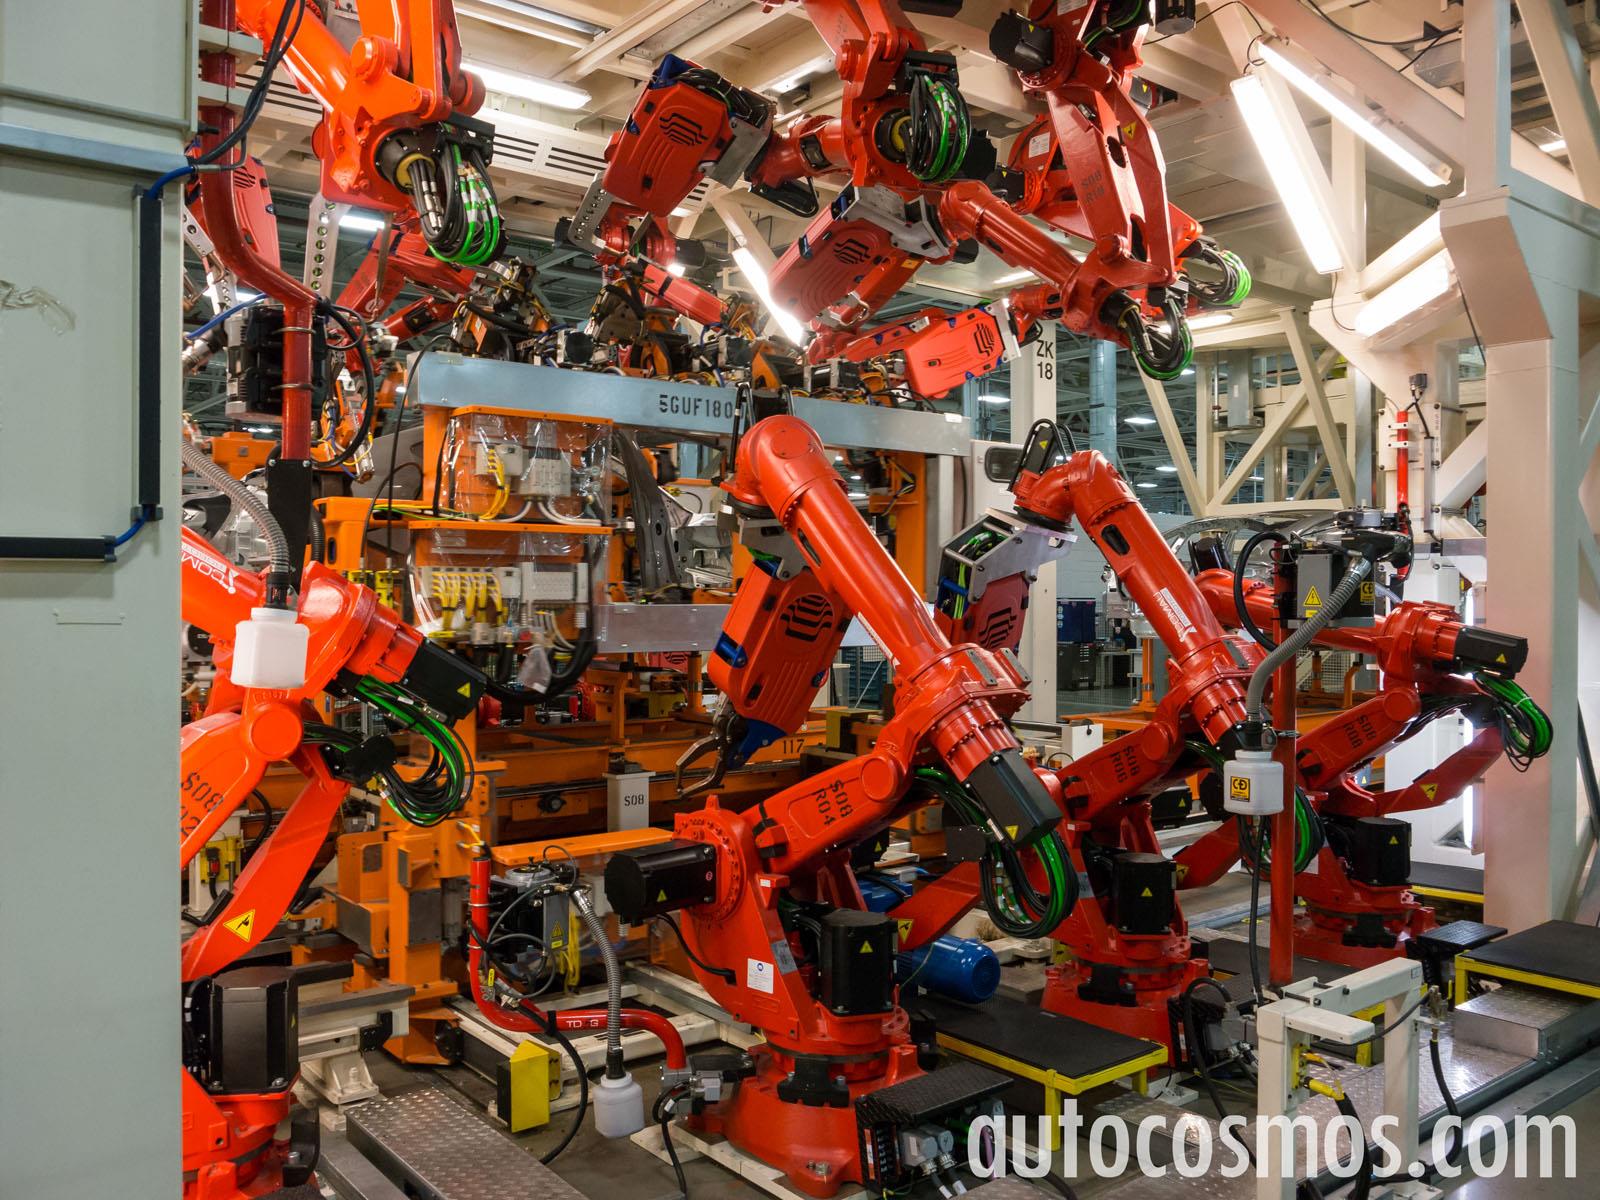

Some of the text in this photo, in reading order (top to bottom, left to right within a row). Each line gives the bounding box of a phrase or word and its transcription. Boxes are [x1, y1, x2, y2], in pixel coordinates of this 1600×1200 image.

[1036, 339, 1054, 359] ZK
[1037, 361, 1053, 380] 18
[624, 793, 645, 807] S08
